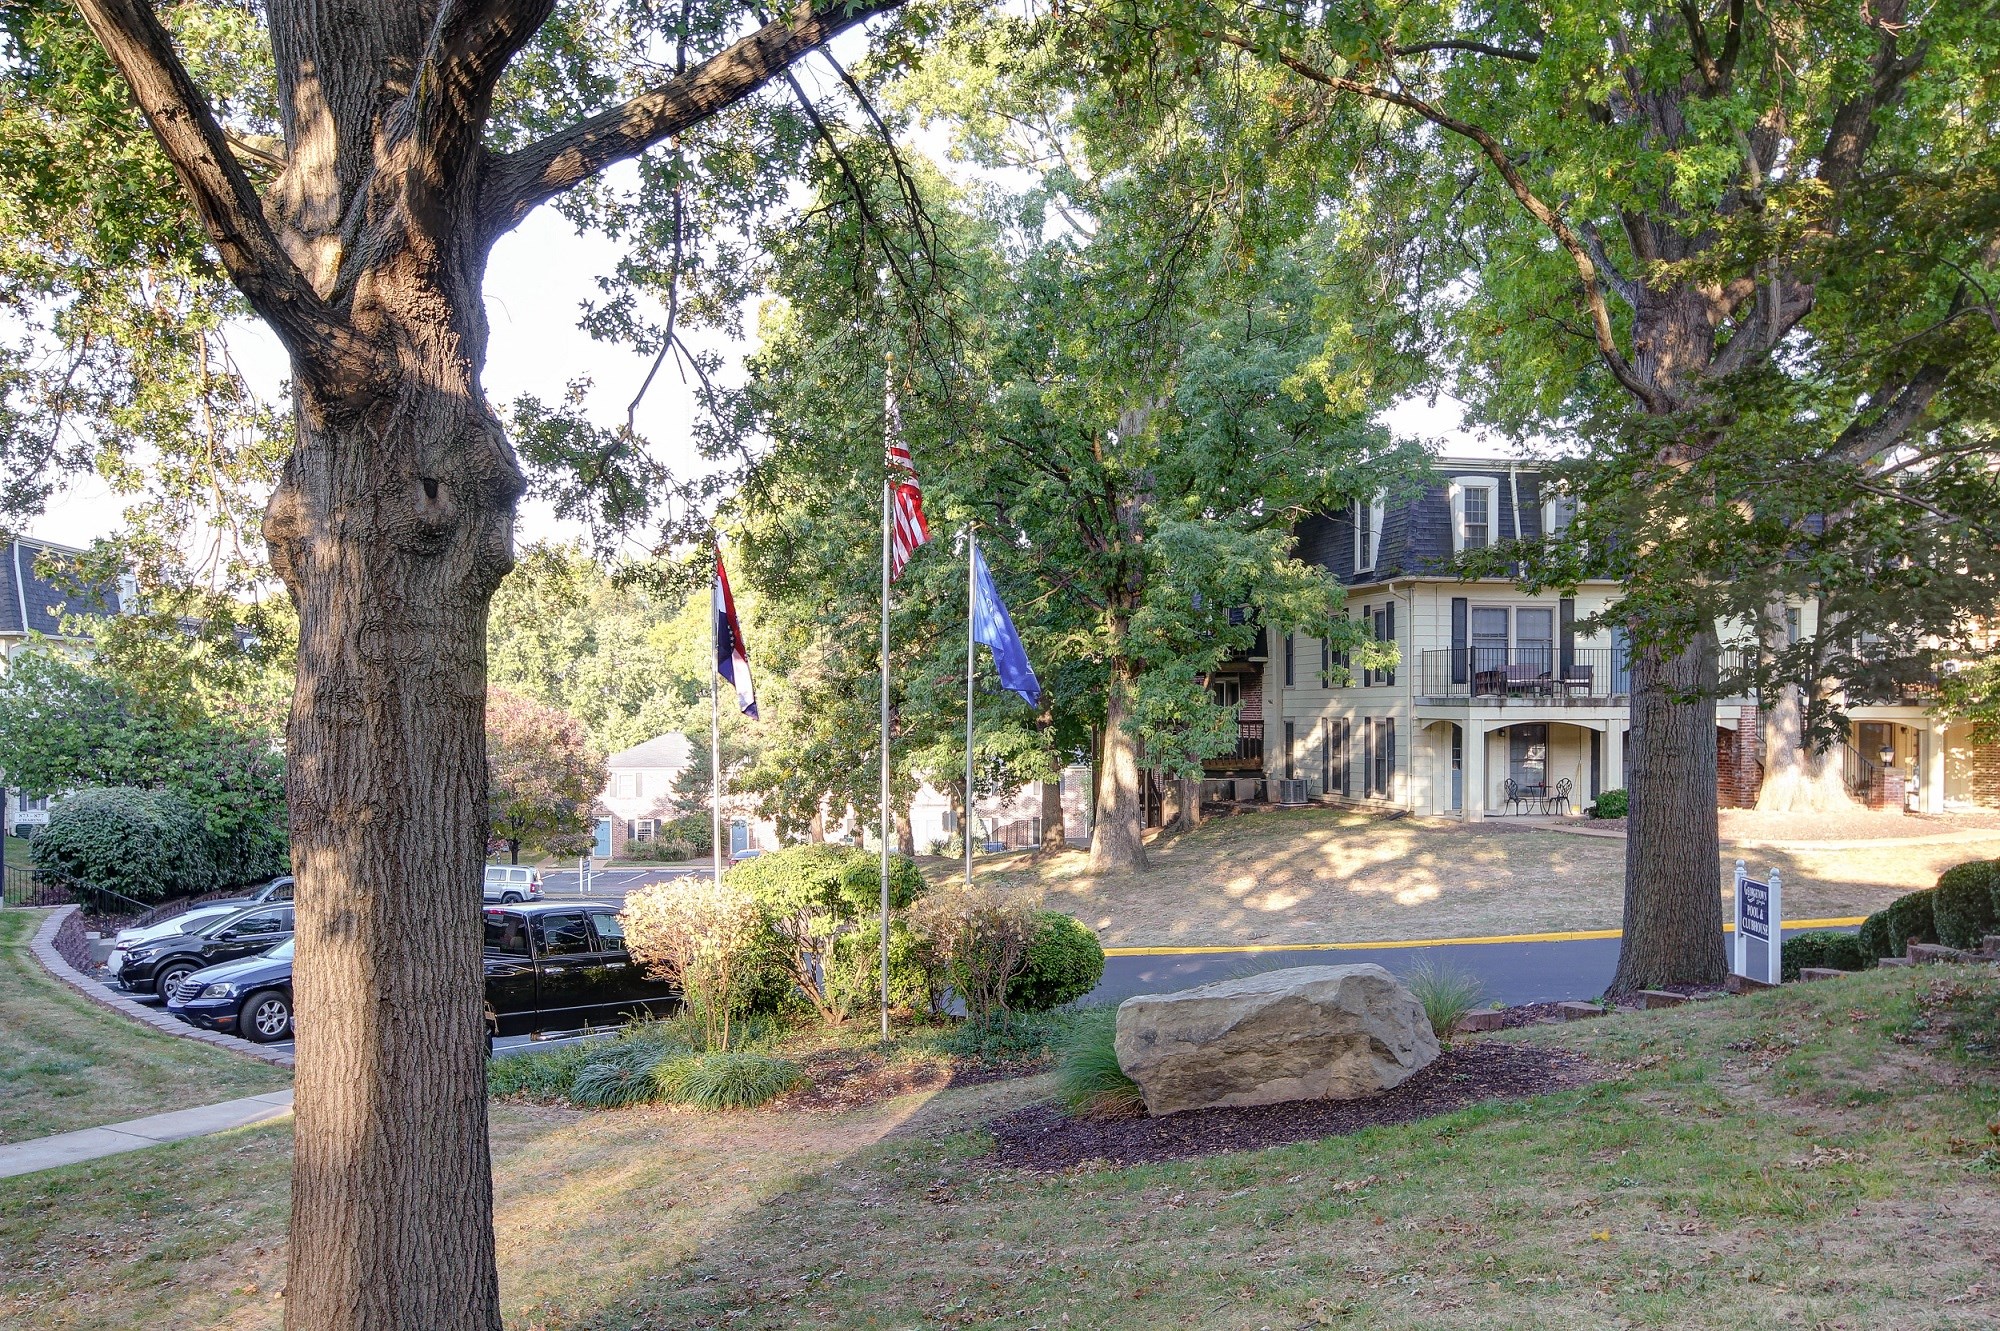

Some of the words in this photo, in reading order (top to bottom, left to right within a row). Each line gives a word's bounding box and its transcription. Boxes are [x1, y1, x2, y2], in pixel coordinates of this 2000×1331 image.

[1747, 904, 1759, 918] POOL
[1760, 908, 1764, 920] &
[1742, 916, 1768, 936] CLUBHOUSE
